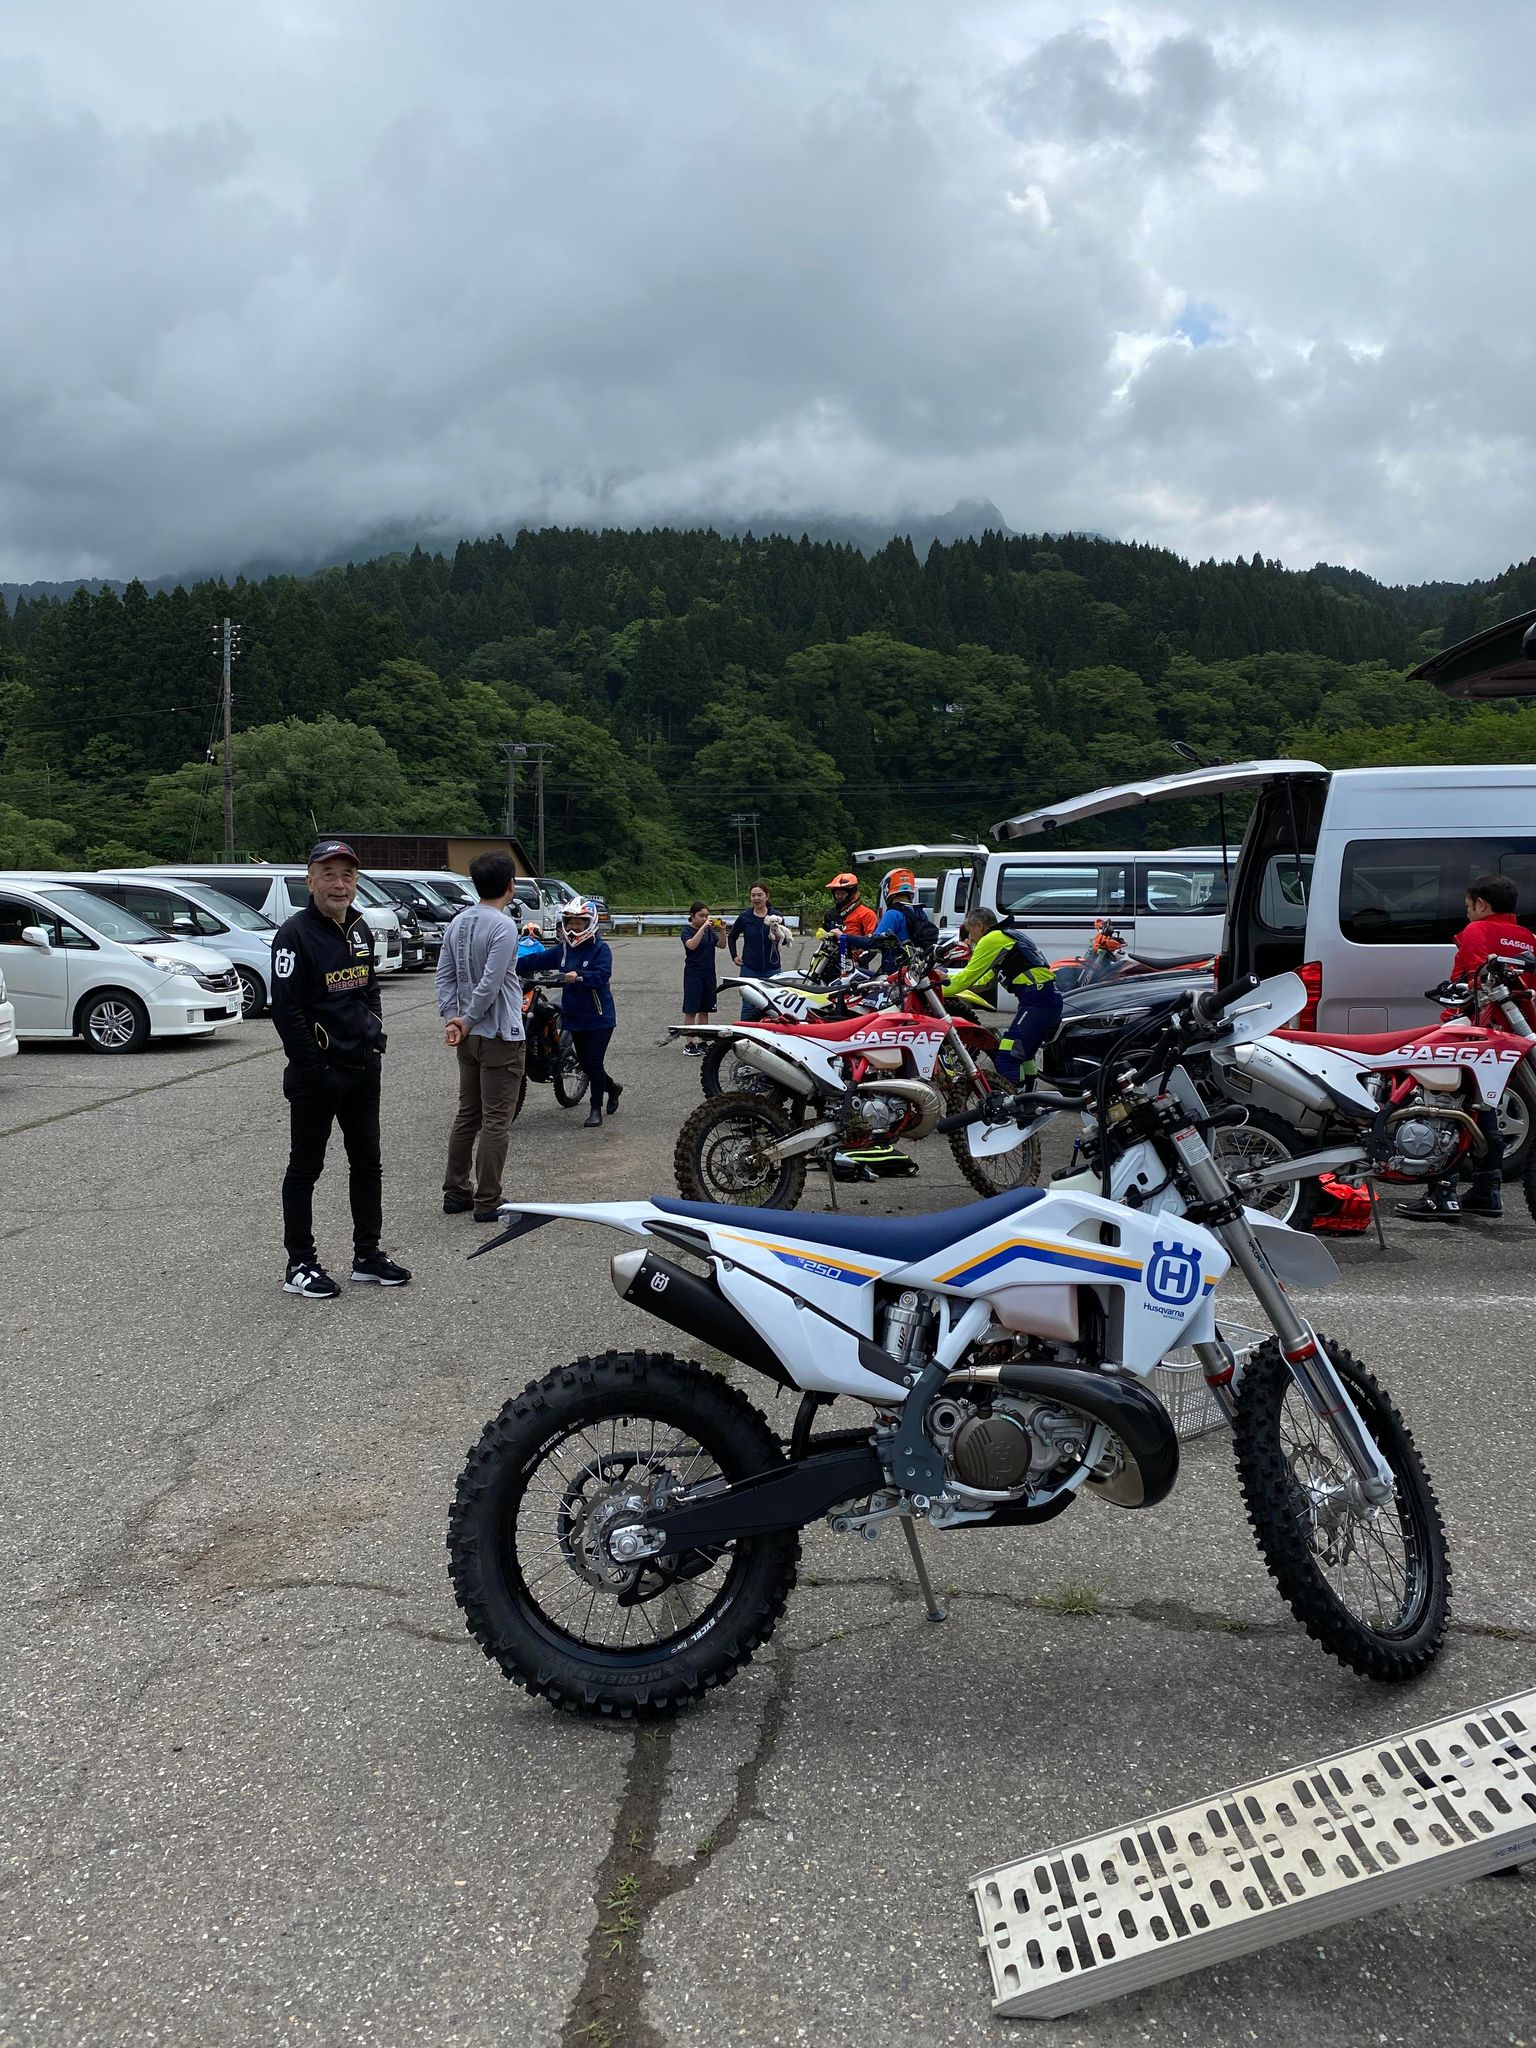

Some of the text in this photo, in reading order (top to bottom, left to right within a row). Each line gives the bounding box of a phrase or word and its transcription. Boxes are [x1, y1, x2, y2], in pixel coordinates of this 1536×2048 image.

[1500, 938, 1534, 951] GASGAS
[773, 989, 807, 1014] 201
[850, 1031, 945, 1044] GASGAS
[1396, 1045, 1521, 1065] GASGAS
[803, 1260, 842, 1280] 250
[1143, 1302, 1185, 1318] Husqvarna
[539, 1430, 565, 1453] EXCEL
[690, 1617, 716, 1641] EXCEL
[578, 1669, 662, 1687] MICHELIN
